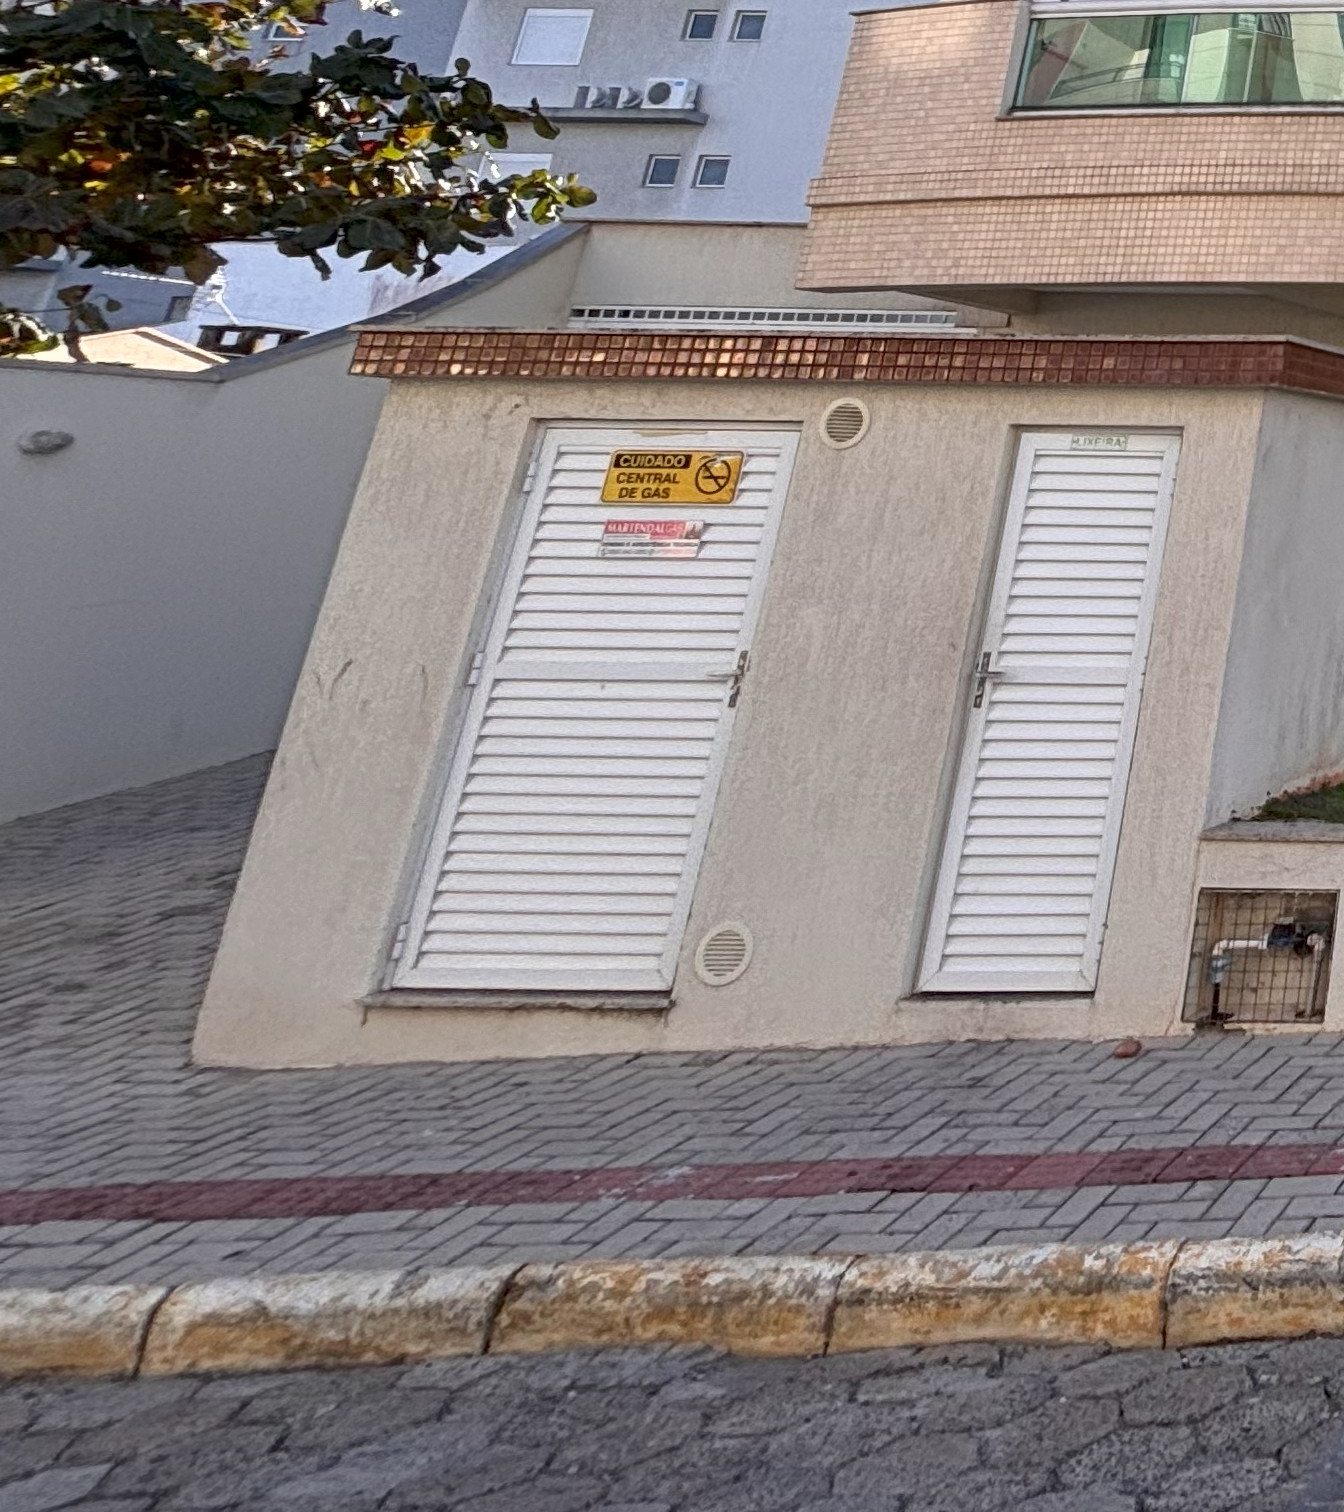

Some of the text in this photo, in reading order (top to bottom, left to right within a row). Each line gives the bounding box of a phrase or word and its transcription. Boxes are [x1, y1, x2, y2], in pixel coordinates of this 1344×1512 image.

[620, 455, 686, 467] CUIDADO
[616, 472, 680, 484] CENTRAL
[618, 488, 637, 499] DE
